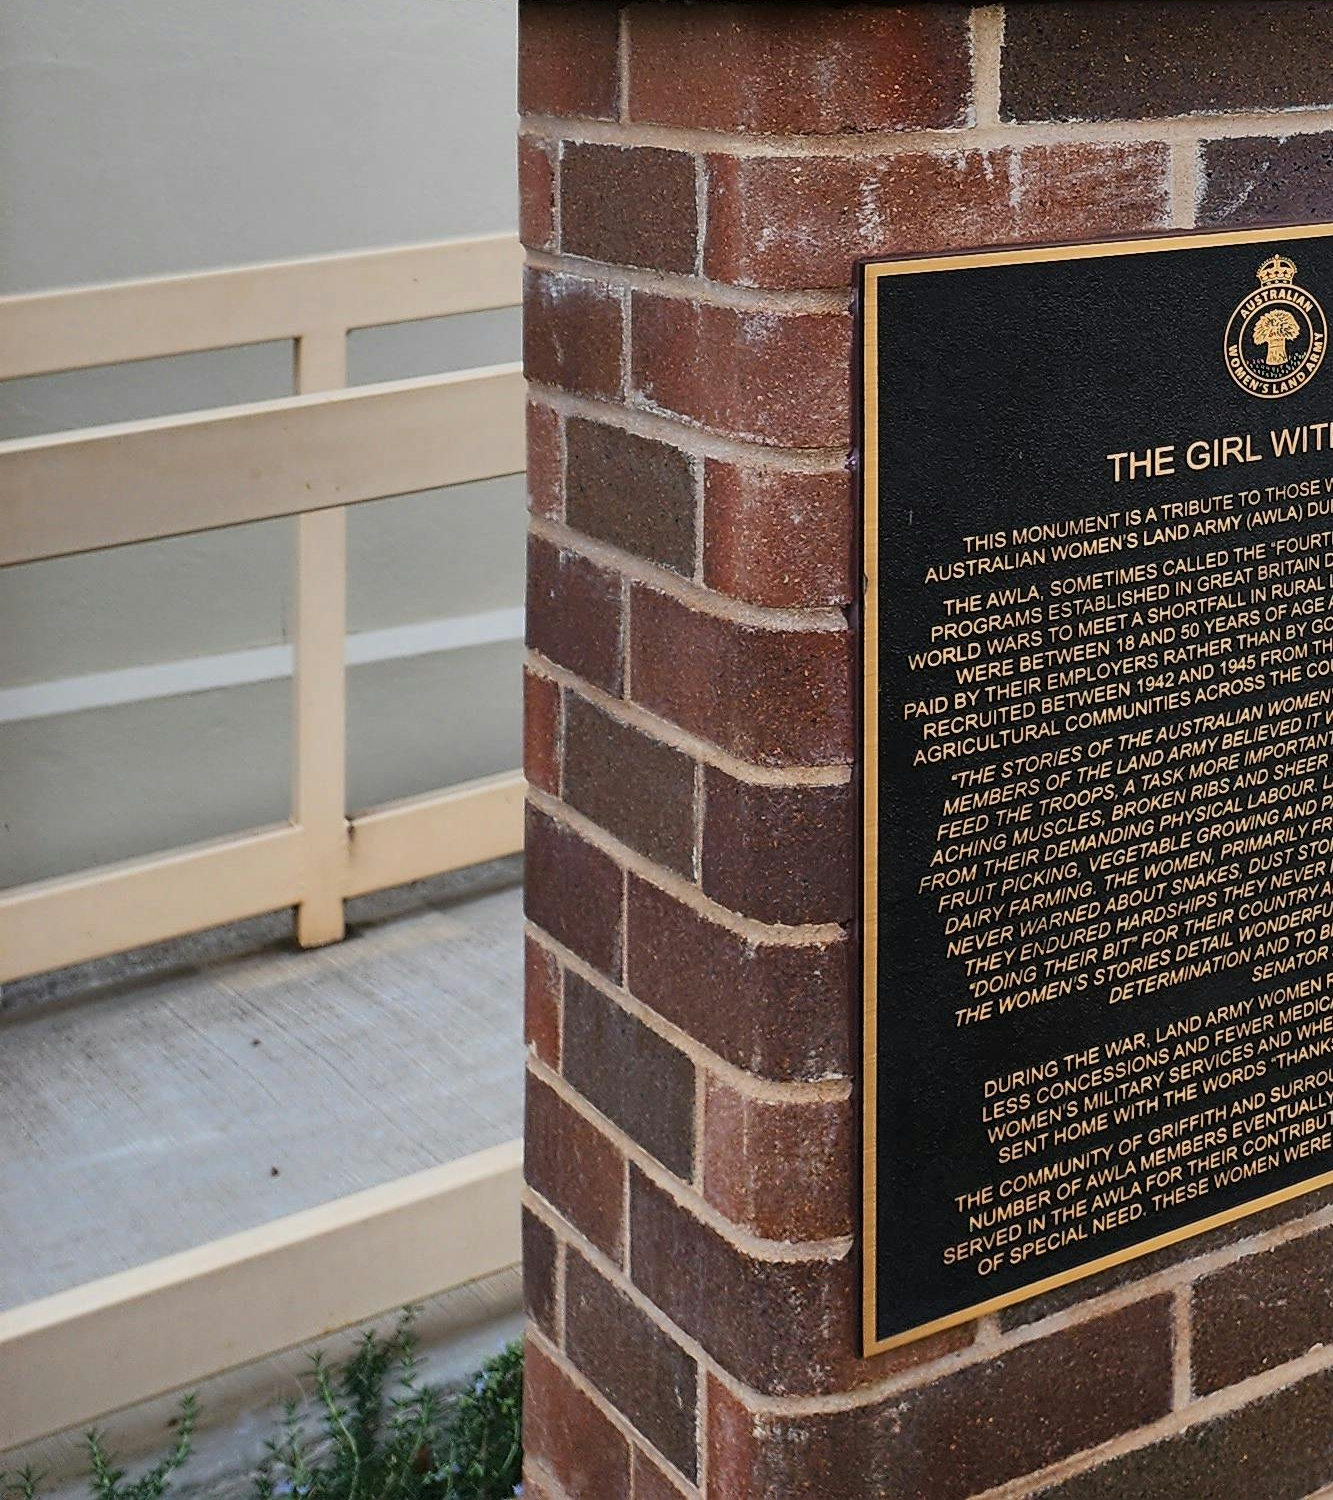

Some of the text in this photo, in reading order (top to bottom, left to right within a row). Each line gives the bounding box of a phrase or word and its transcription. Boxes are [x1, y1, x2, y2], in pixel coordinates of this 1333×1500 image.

[1240, 289, 1314, 320] AUSTRALIAN
[1228, 332, 1324, 394] WOMEN'S LAND ARMY
[1106, 445, 1174, 481] THE
[1186, 434, 1262, 470] GIRL
[925, 548, 1045, 583] AUSTRALIAN
[1050, 532, 1138, 561] WOMEN'S
[1143, 523, 1189, 545] LAND
[1192, 514, 1242, 537] ARMY
[1246, 504, 1302, 530] (AWLA)
[962, 531, 1006, 552] THIS
[1012, 512, 1120, 544] MONUMENT
[1125, 509, 1141, 526] IS
[1145, 507, 1157, 522] A
[1160, 493, 1232, 519] TRIBUTE
[1238, 489, 1260, 506] TO
[1264, 479, 1320, 501] THOSE
[908, 642, 980, 670] WORLD
[987, 630, 1042, 655] WARS
[1047, 624, 1072, 642] TO
[1078, 613, 1128, 637] MEET
[1131, 611, 1143, 627] A
[1147, 592, 1246, 623] SHORTFALL
[1251, 587, 1266, 603] IN
[1271, 576, 1325, 599] RURAL
[931, 607, 1042, 642] PROGRAMS
[1048, 583, 1169, 619] ESTABLISHED
[1175, 579, 1191, 596] IN
[1197, 567, 1253, 591] GREAT
[1258, 555, 1319, 580] BRITAIN
[913, 720, 1060, 765] AGRICULTURAL
[1065, 690, 1190, 731] COMMUNITIES
[1194, 674, 1265, 703] ACROSS
[1269, 665, 1301, 685] THE
[943, 778, 1040, 815] MEMBERS
[1045, 770, 1072, 790] OF
[1077, 760, 1112, 783] THE
[1116, 749, 1163, 774] LAND
[1166, 736, 1218, 762] ARMY
[1221, 717, 1301, 749] BELIEVED
[1306, 711, 1321, 729] IT
[929, 833, 1006, 866] ACHING
[1012, 809, 1104, 846] MUSCLES,
[1111, 788, 1186, 821] BROKEN
[1190, 777, 1230, 801] RIBS
[1232, 768, 1268, 790] AND
[1273, 753, 1328, 780] SHEER
[965, 947, 1016, 976] THEY
[1019, 921, 1111, 961] ENDURED
[1116, 891, 1217, 933] HARDSHIPS
[1222, 876, 1267, 902] THEY
[1270, 860, 1326, 889] NEVER
[1251, 945, 1328, 981] SENATOR
[982, 1093, 1030, 1122] LESS
[1036, 1047, 1169, 1103] CONCESSIONS
[1173, 1035, 1209, 1060] AND
[1215, 1014, 1273, 1045] FEWER
[984, 1060, 1058, 1097] DURING
[1063, 1046, 1099, 1071] THE
[1104, 1032, 1149, 1058] WAR,
[1156, 1015, 1201, 1042] LAND
[1205, 998, 1253, 1026] ARMY
[1258, 976, 1321, 1009] WOMEN
[987, 1100, 1078, 1143] WOMEN'S
[1084, 1071, 1163, 1111] MILITARY
[1168, 1042, 1253, 1083] SERVICES
[1257, 1030, 1291, 1053] AND
[954, 1185, 992, 1211] THE
[999, 1144, 1112, 1196] COMMUNITY
[1118, 1133, 1142, 1155] OF
[1147, 1105, 1226, 1145] GRIFFITH
[1230, 1092, 1265, 1117] AND
[969, 1189, 1050, 1231] NUMBER
[1056, 1177, 1081, 1200] OF
[1085, 1159, 1136, 1190] AWLA
[1140, 1127, 1227, 1170] MEMBERS
